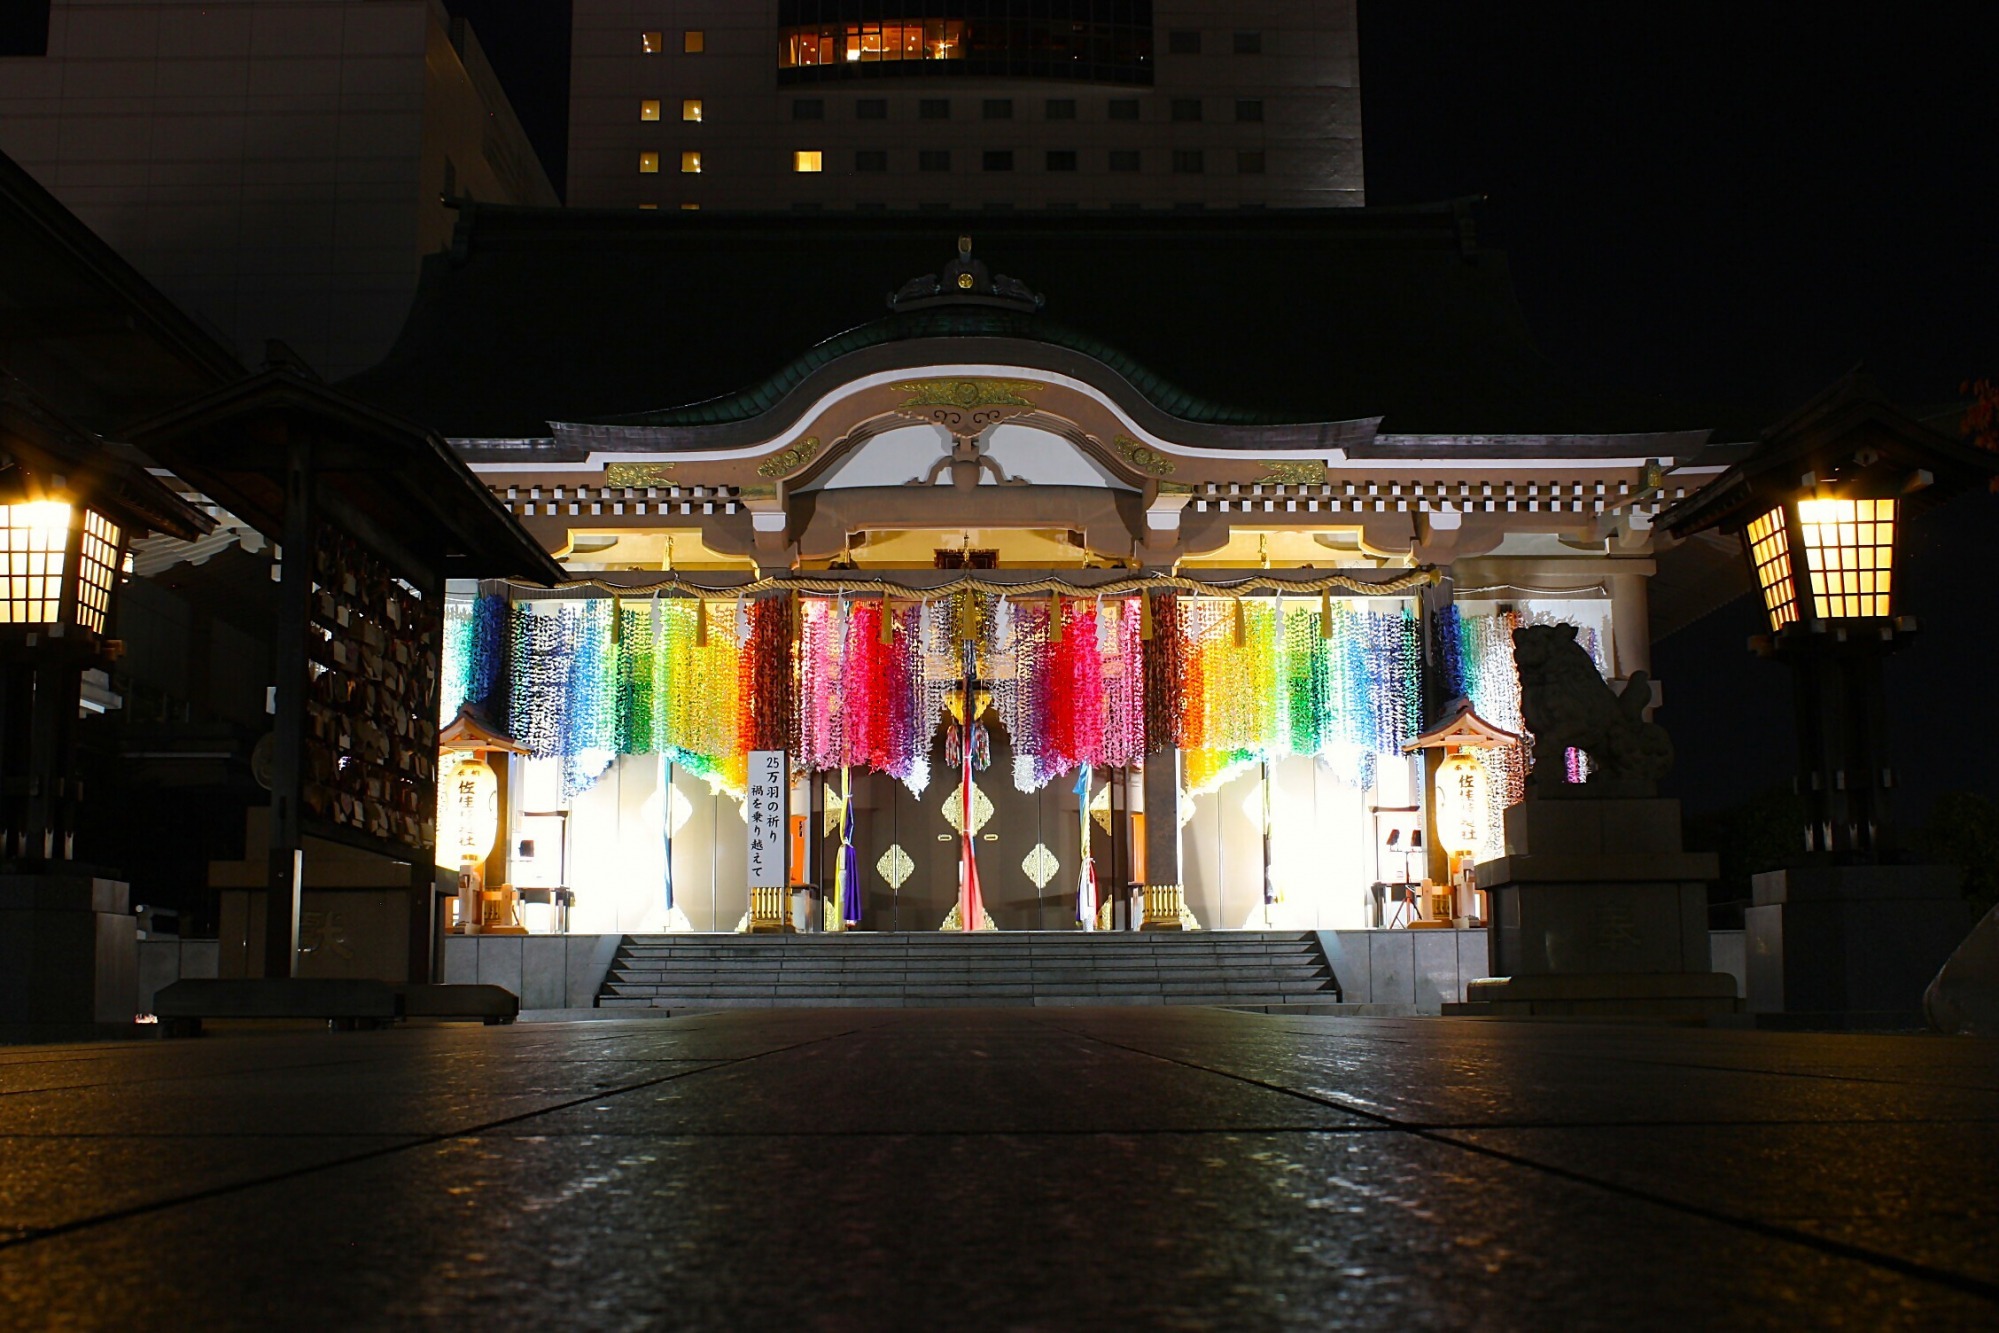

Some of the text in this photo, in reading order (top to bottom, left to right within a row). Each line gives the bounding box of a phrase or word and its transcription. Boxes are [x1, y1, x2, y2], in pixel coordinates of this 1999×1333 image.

[750, 785, 764, 877] 禍を乗り越えて
[766, 757, 780, 843] 25万羽の祈り
